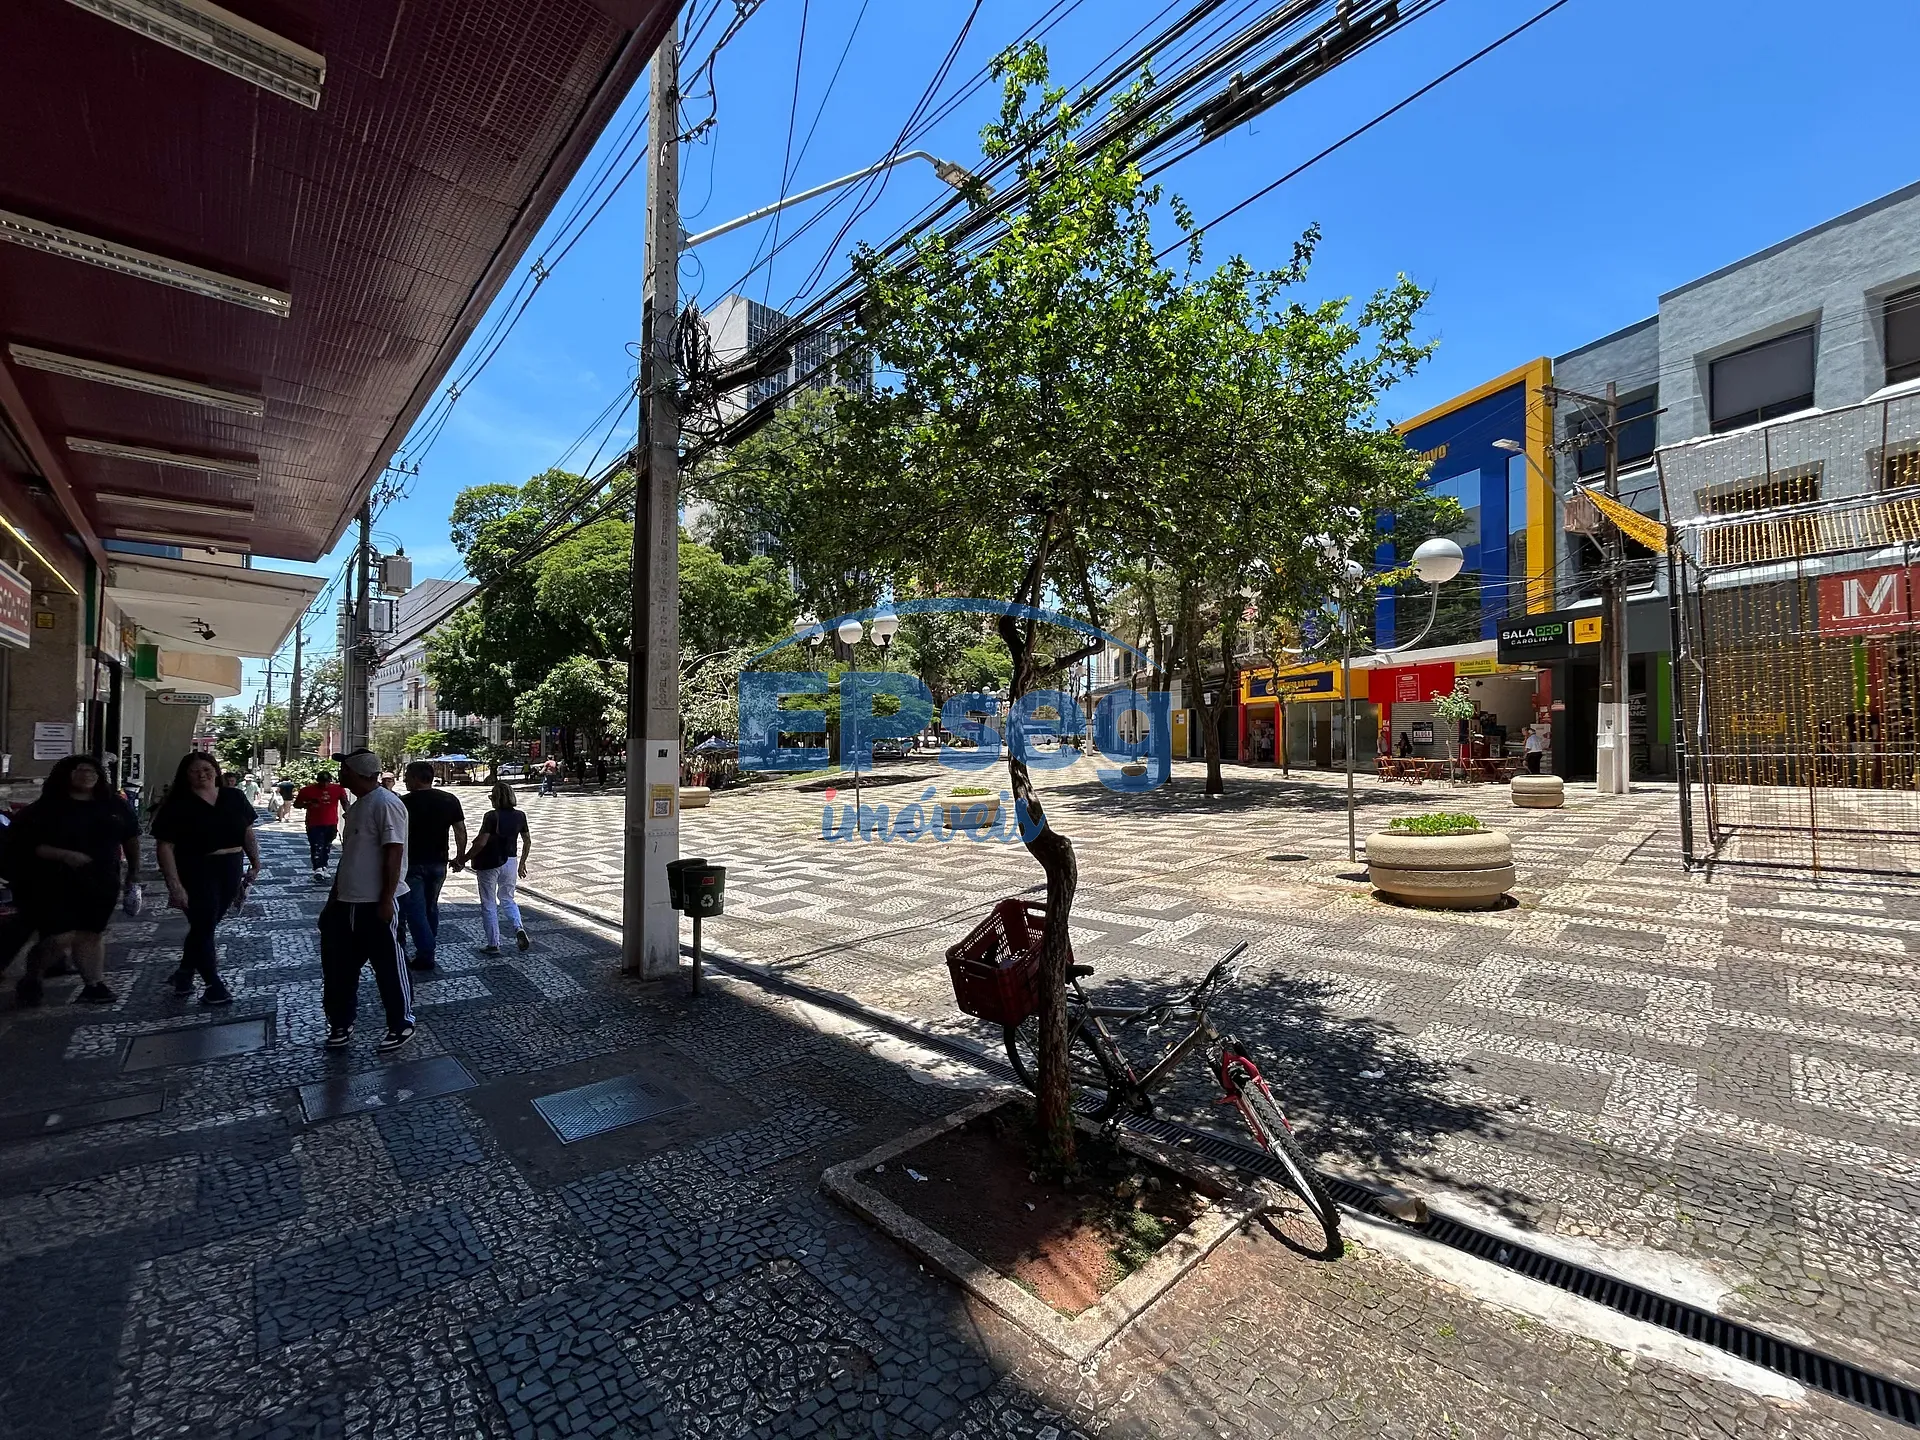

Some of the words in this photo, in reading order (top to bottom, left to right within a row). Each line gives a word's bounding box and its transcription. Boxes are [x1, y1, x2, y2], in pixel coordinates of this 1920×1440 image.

[1842, 574, 1899, 617] M
[1503, 628, 1534, 640] SALA
[1536, 624, 1563, 637] PRO
[1511, 636, 1554, 645] CAROLINA
